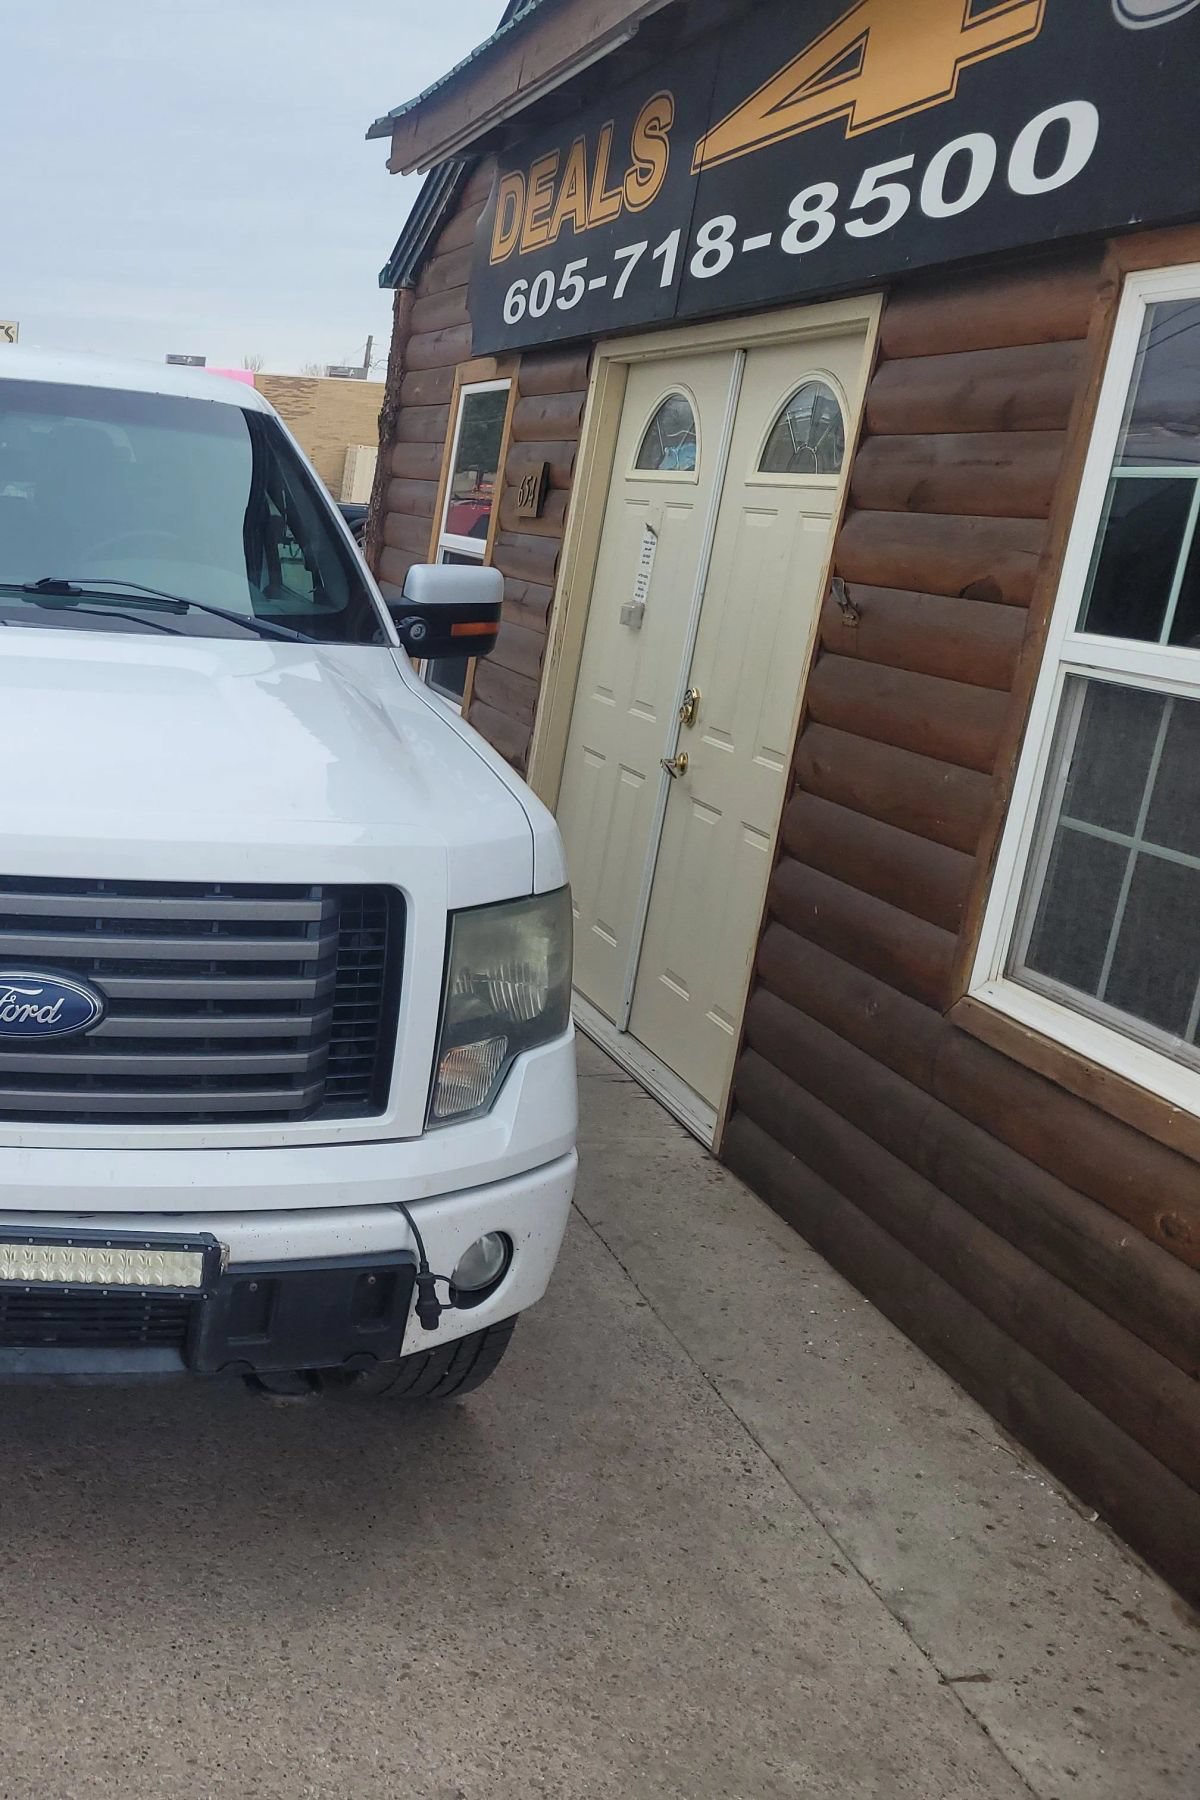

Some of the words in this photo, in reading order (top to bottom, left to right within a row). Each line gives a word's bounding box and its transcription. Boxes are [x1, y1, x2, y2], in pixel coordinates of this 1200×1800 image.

[489, 89, 675, 266] DEALS
[502, 100, 1100, 325] 605-718-8500
[518, 475, 538, 508] 654
